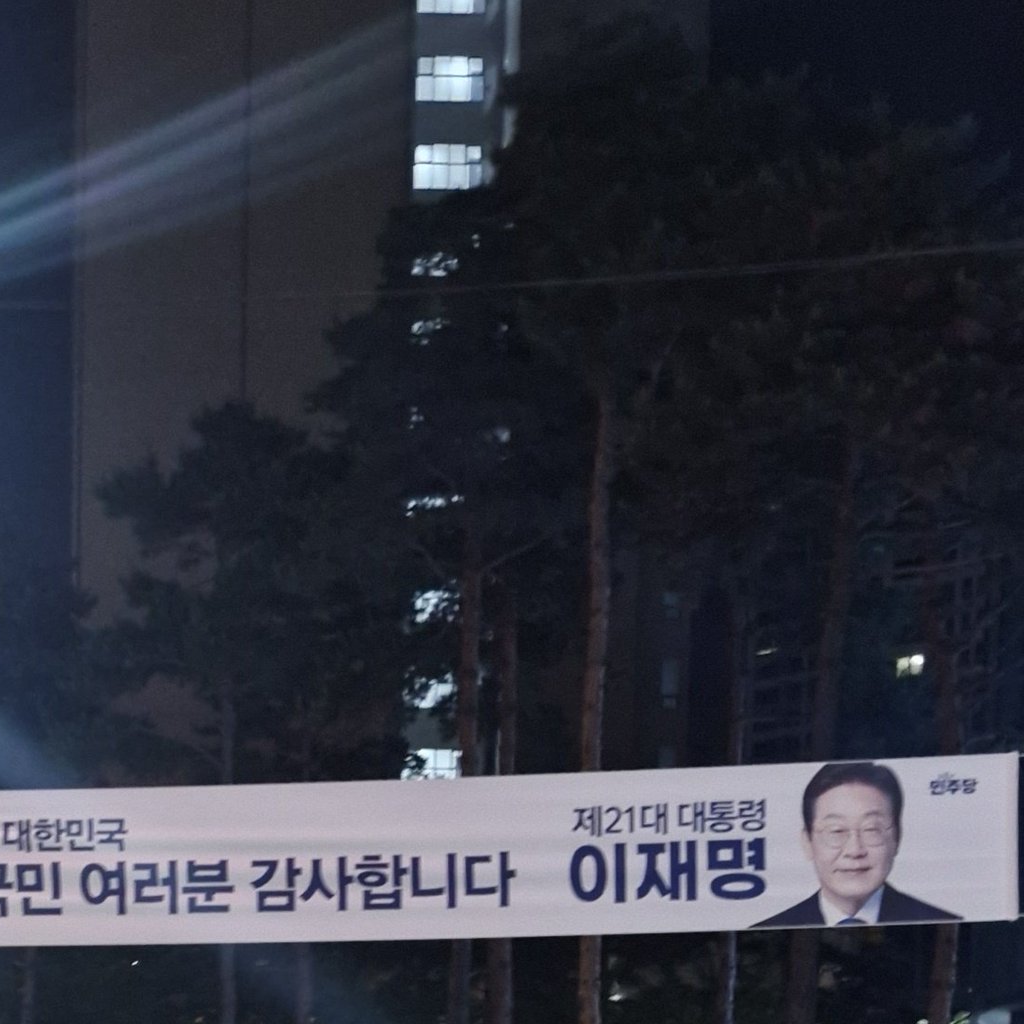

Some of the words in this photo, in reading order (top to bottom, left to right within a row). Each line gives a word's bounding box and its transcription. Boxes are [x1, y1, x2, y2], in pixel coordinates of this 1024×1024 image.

[929, 778, 979, 796] 민주당
[1, 817, 128, 853] 대한민국
[571, 801, 669, 837] 제21대
[677, 798, 768, 835] 대통령
[79, 858, 235, 916] 여러분
[249, 850, 517, 912] 감사합니다
[569, 836, 769, 904] 이재명
